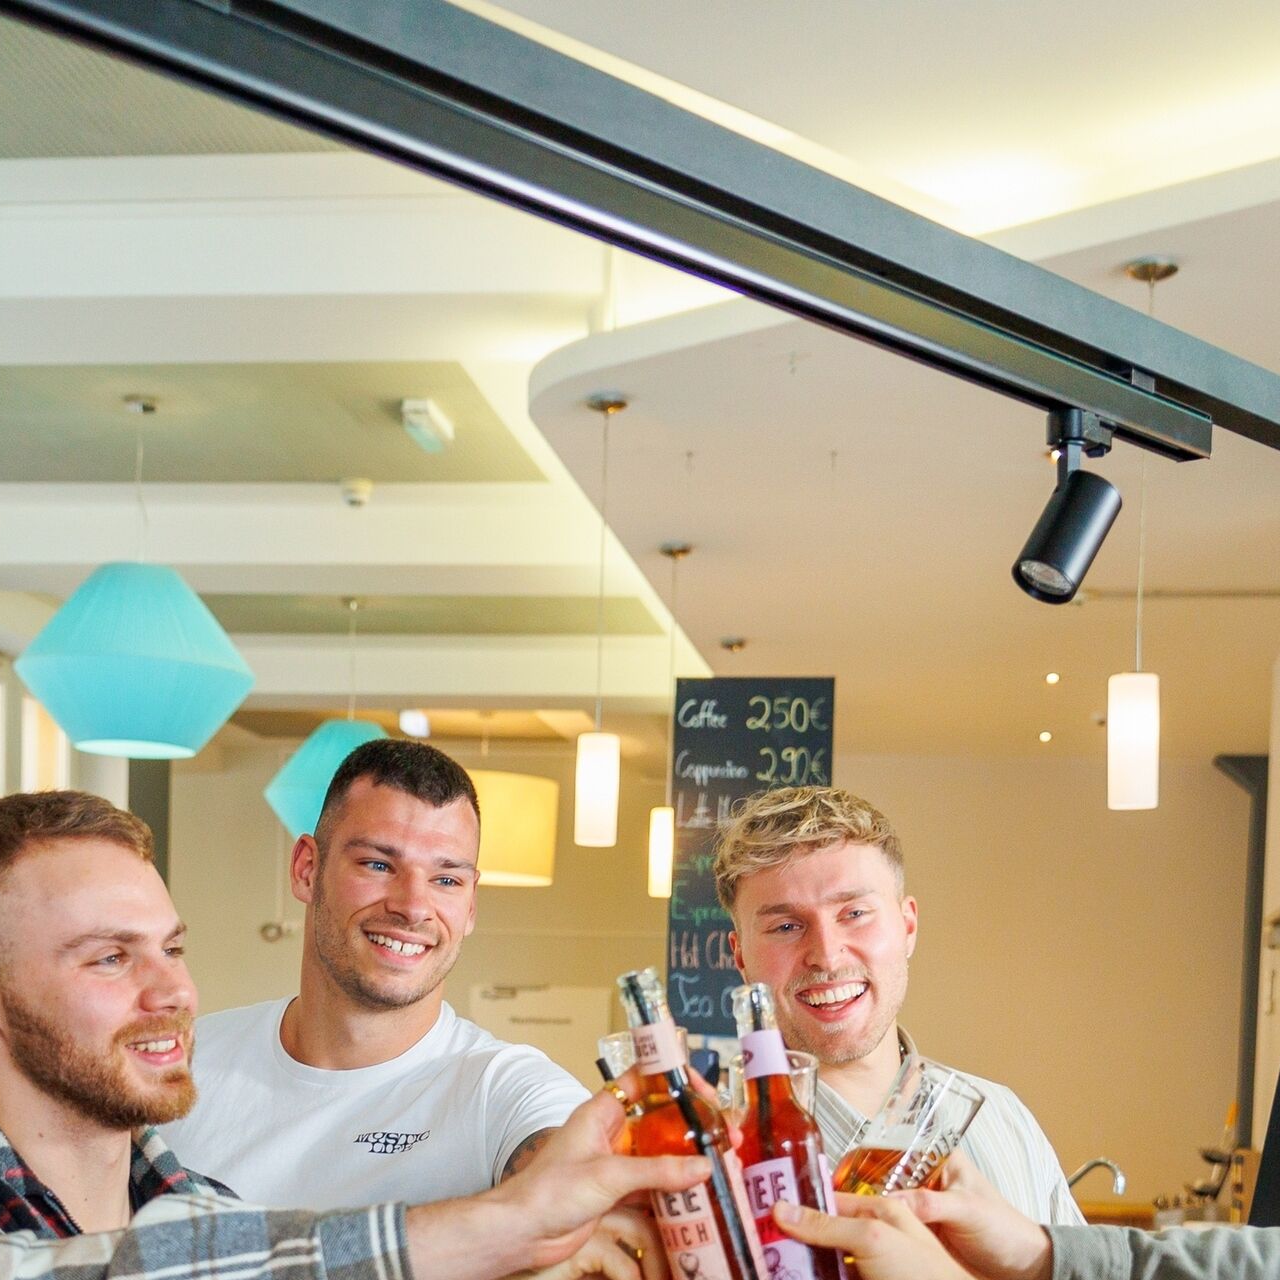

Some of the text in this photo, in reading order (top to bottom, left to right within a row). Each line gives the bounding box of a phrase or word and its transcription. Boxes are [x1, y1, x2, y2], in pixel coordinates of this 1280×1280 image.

[677, 698, 728, 729] Coffee
[353, 1129, 431, 1146] MYSTIC
[368, 1141, 414, 1155] LIFE
